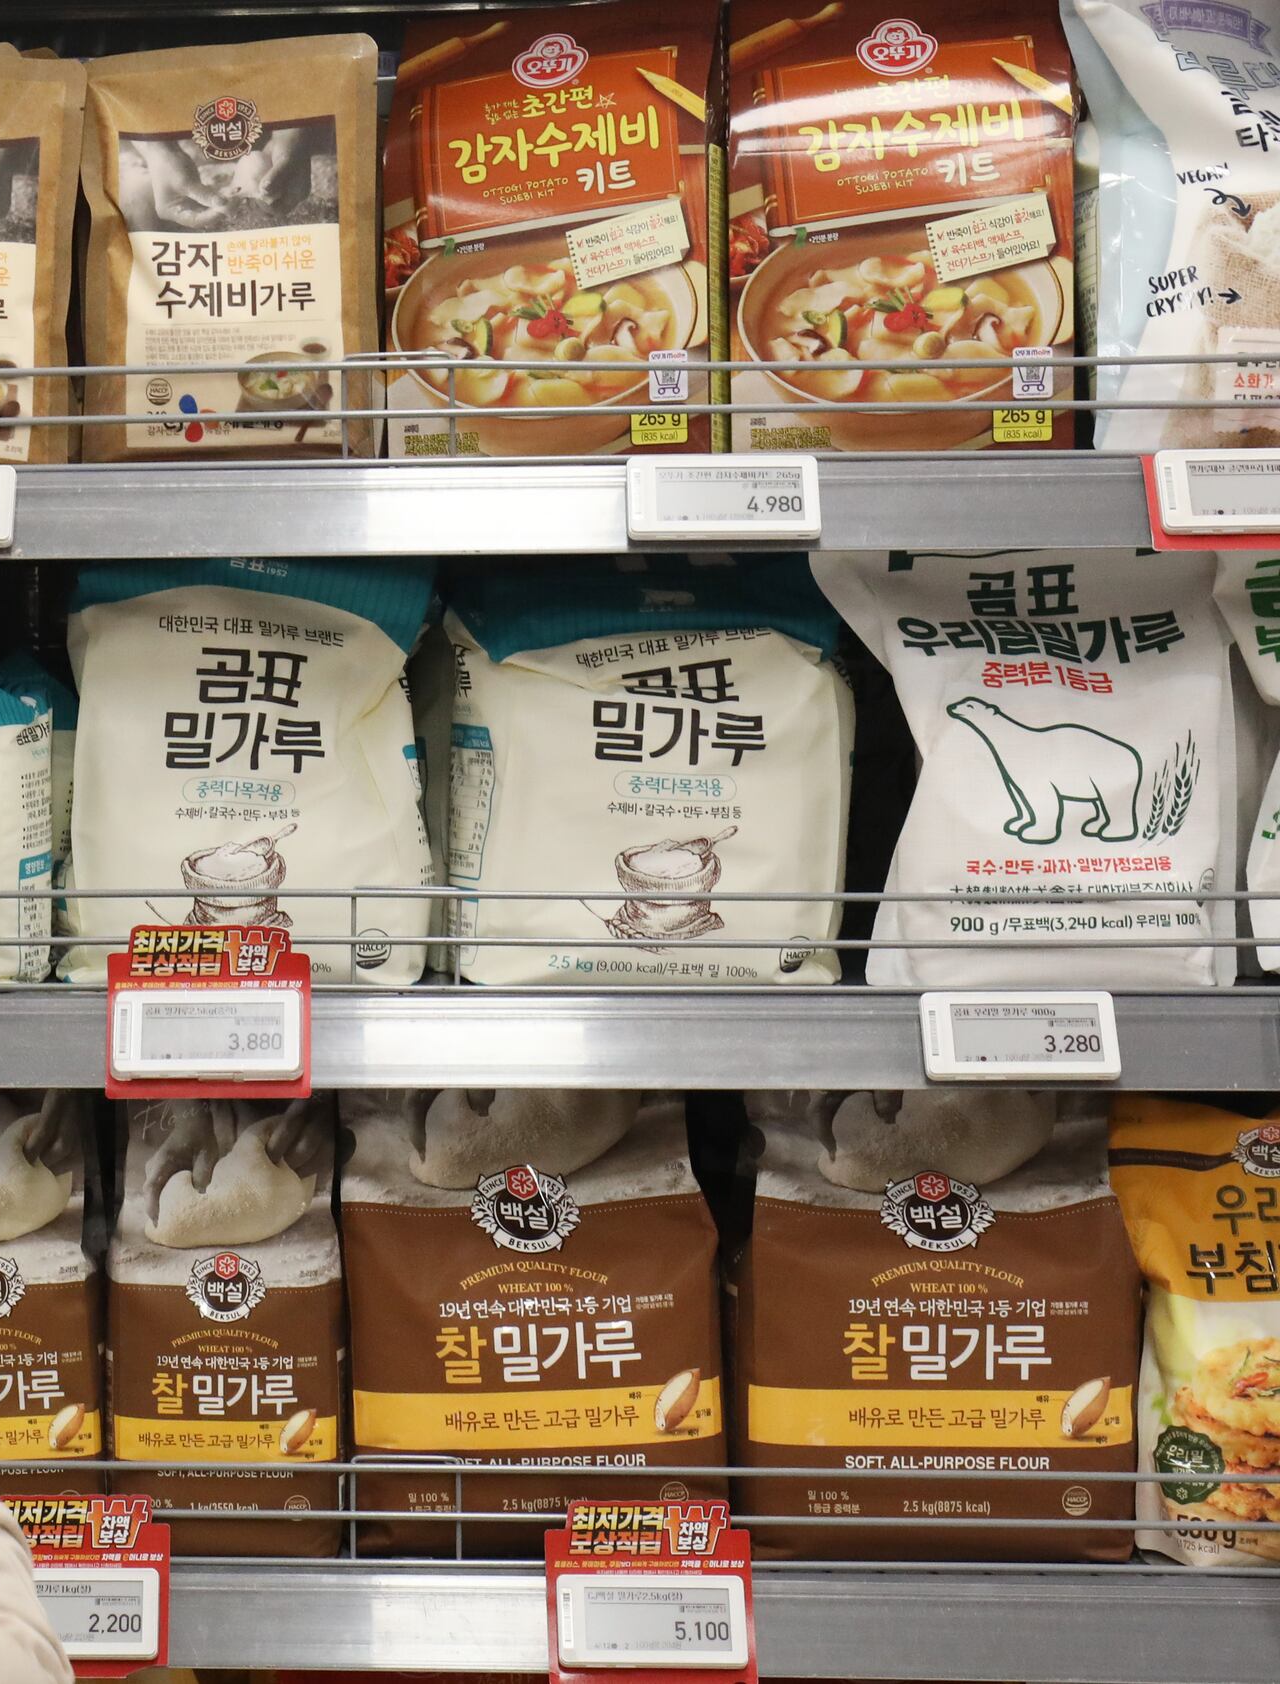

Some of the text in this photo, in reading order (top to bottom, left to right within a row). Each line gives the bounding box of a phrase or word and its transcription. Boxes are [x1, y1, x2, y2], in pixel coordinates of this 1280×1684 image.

[873, 45, 922, 61] 오뚜기
[527, 58, 573, 75] 오뚜기
[210, 122, 243, 141] 백설
[798, 98, 1024, 172] 감자수제비
[448, 105, 659, 184] 감자수제비
[577, 160, 636, 194] 키트
[936, 152, 1000, 185] 키트
[483, 177, 568, 198] OTTOGI POTATO
[855, 178, 914, 194] SUJEBI KIT
[152, 241, 223, 277] 감자
[1148, 266, 1199, 294] SUPER
[156, 280, 316, 319] 수제비가루
[639, 414, 680, 426] 265 g
[1001, 410, 1045, 424] 265 g
[641, 431, 678, 441] (835 kcal)
[1004, 430, 1042, 439] (835 kcal)
[967, 564, 1079, 617] 곰표
[159, 616, 344, 647] 대한민국 대표 밀가루 브랜드
[898, 610, 1185, 664] 우리밀밀가루
[196, 648, 308, 708] 곰표
[981, 661, 1113, 694] 중력분 1등급
[164, 712, 325, 773] 밀가루
[593, 700, 766, 766] 밀가루
[628, 776, 724, 797] 중력다목적용
[950, 916, 984, 932] 900
[990, 920, 998, 935] g
[1102, 915, 1133, 929] kcal)
[1136, 915, 1171, 927] 우리밀
[1176, 912, 1201, 926] 100%
[134, 930, 225, 954] 최저가격
[239, 945, 268, 960] 차액
[359, 943, 386, 952] HACCP
[236, 960, 267, 972] 보상
[576, 957, 593, 972] kg
[709, 965, 719, 977] 밀
[726, 966, 758, 977] 100%
[891, 1184, 975, 1200] SINCE 1953
[500, 1202, 549, 1230] 백설
[910, 1204, 963, 1230] 백설
[509, 1239, 551, 1250] BEKSUL
[920, 1238, 966, 1249] BEKSUL
[460, 1262, 609, 1290] PREMIUM QUALITY FLOUR
[207, 1281, 243, 1303] 백설
[210, 1311, 241, 1320] BEKSUL
[439, 1301, 470, 1319] 19년
[473, 1300, 505, 1318] 연속
[508, 1298, 572, 1317] 대한민국
[576, 1298, 599, 1314] 1등
[602, 1296, 632, 1313] 기업
[849, 1298, 1046, 1318] 19년 연속 대한민국 1등 기업
[171, 1329, 279, 1350] PREMIUM QUALITY FLOUR
[436, 1321, 641, 1384] 찰 밀가루
[843, 1324, 1052, 1380] 찰 밀가루
[157, 1356, 293, 1370] 19년 연속 대한민국 1등 기업
[152, 1373, 298, 1416] 찰 밀가루
[445, 1406, 639, 1432] 배유로 만든 고급 밀가루
[6, 1430, 44, 1447] 밀가루
[139, 1433, 275, 1448] 배유로 만든 고급 밀가루
[845, 1456, 1050, 1470] SOFT, ALL-PURPOSE FLOUR
[102, 1516, 130, 1529] 차액
[572, 1506, 664, 1530] 최저가격
[679, 1522, 708, 1535] 차액
[99, 1530, 129, 1544] 보상
[678, 1536, 707, 1550] 보상
[1198, 1542, 1220, 1554] kcal)
[89, 1614, 141, 1634] 2,200
[675, 1621, 729, 1641] 5,100
